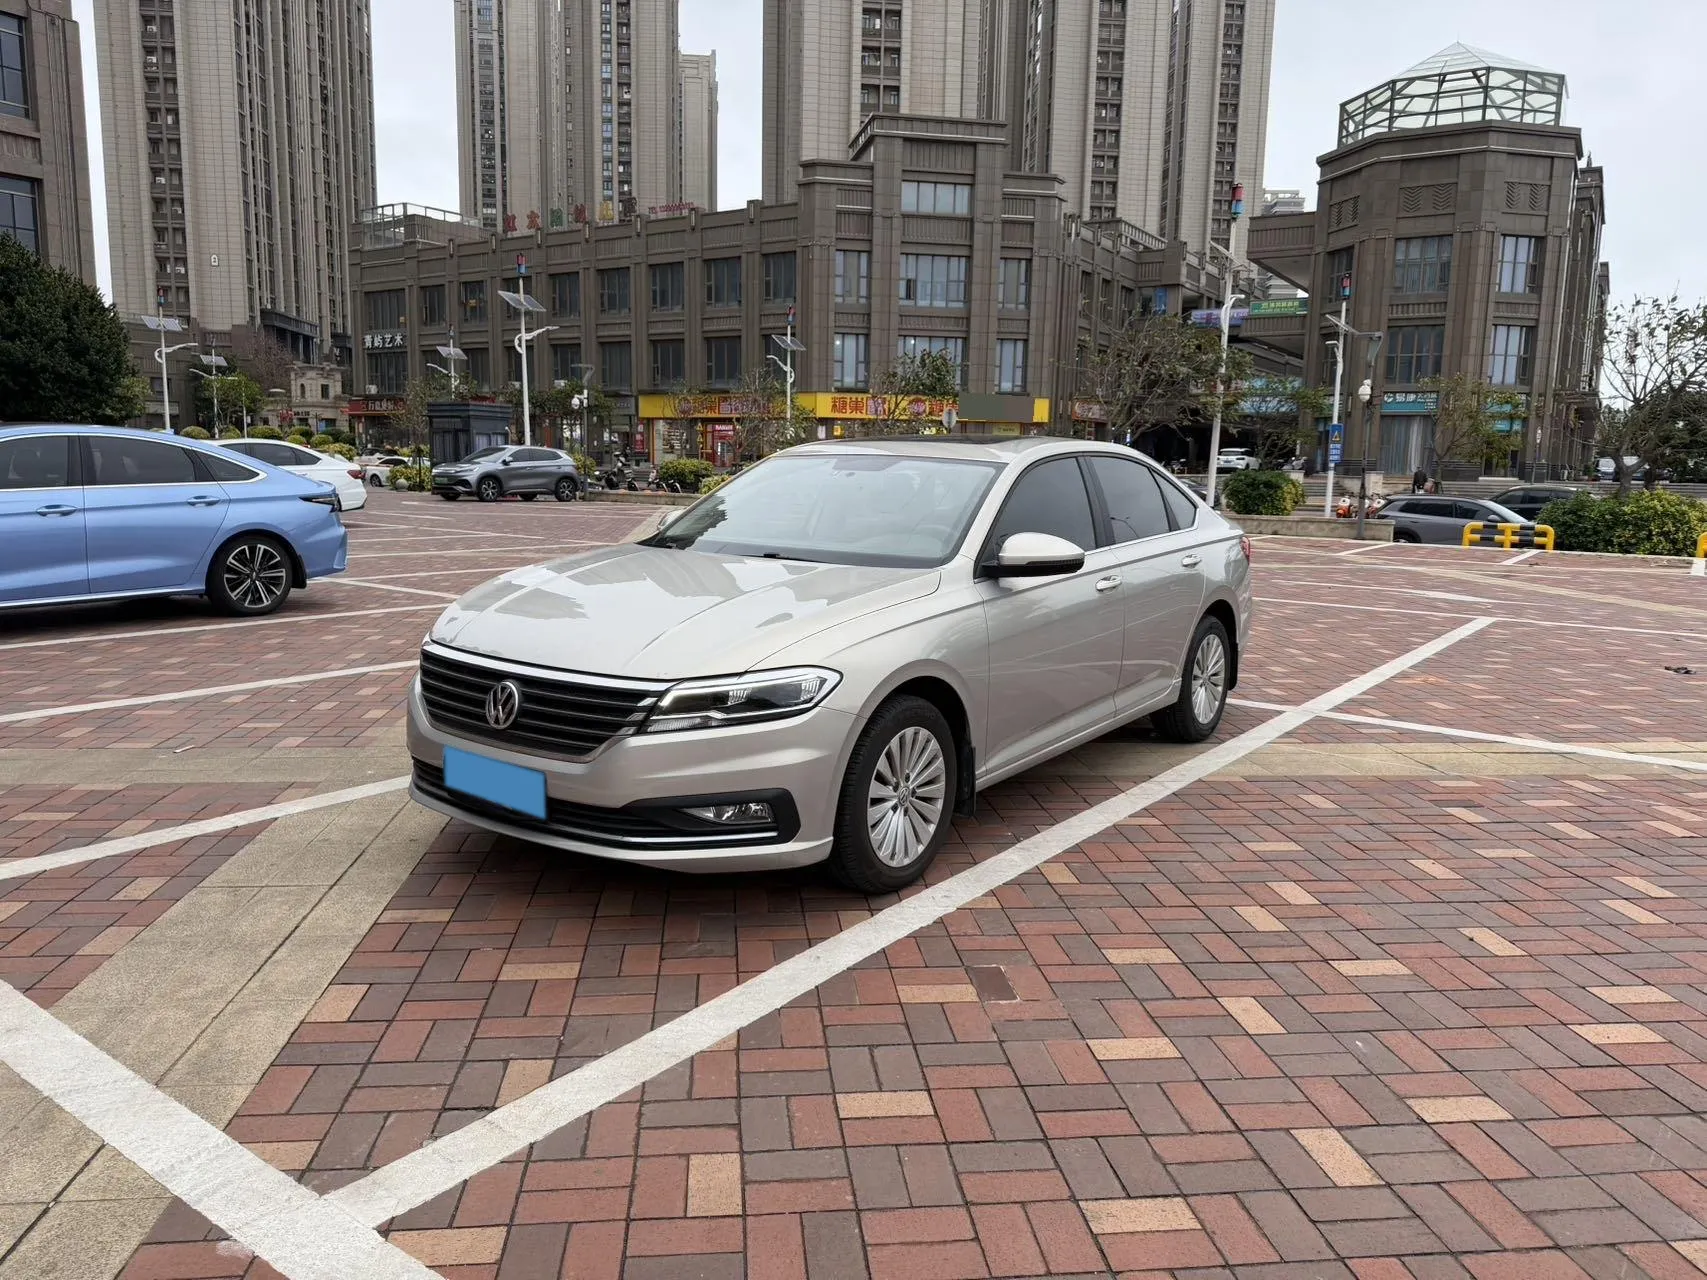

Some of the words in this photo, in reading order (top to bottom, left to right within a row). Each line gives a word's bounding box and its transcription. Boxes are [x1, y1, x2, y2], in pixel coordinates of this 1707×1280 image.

[364, 333, 403, 348] 青屿艺术
[831, 396, 864, 414] 糖巢
